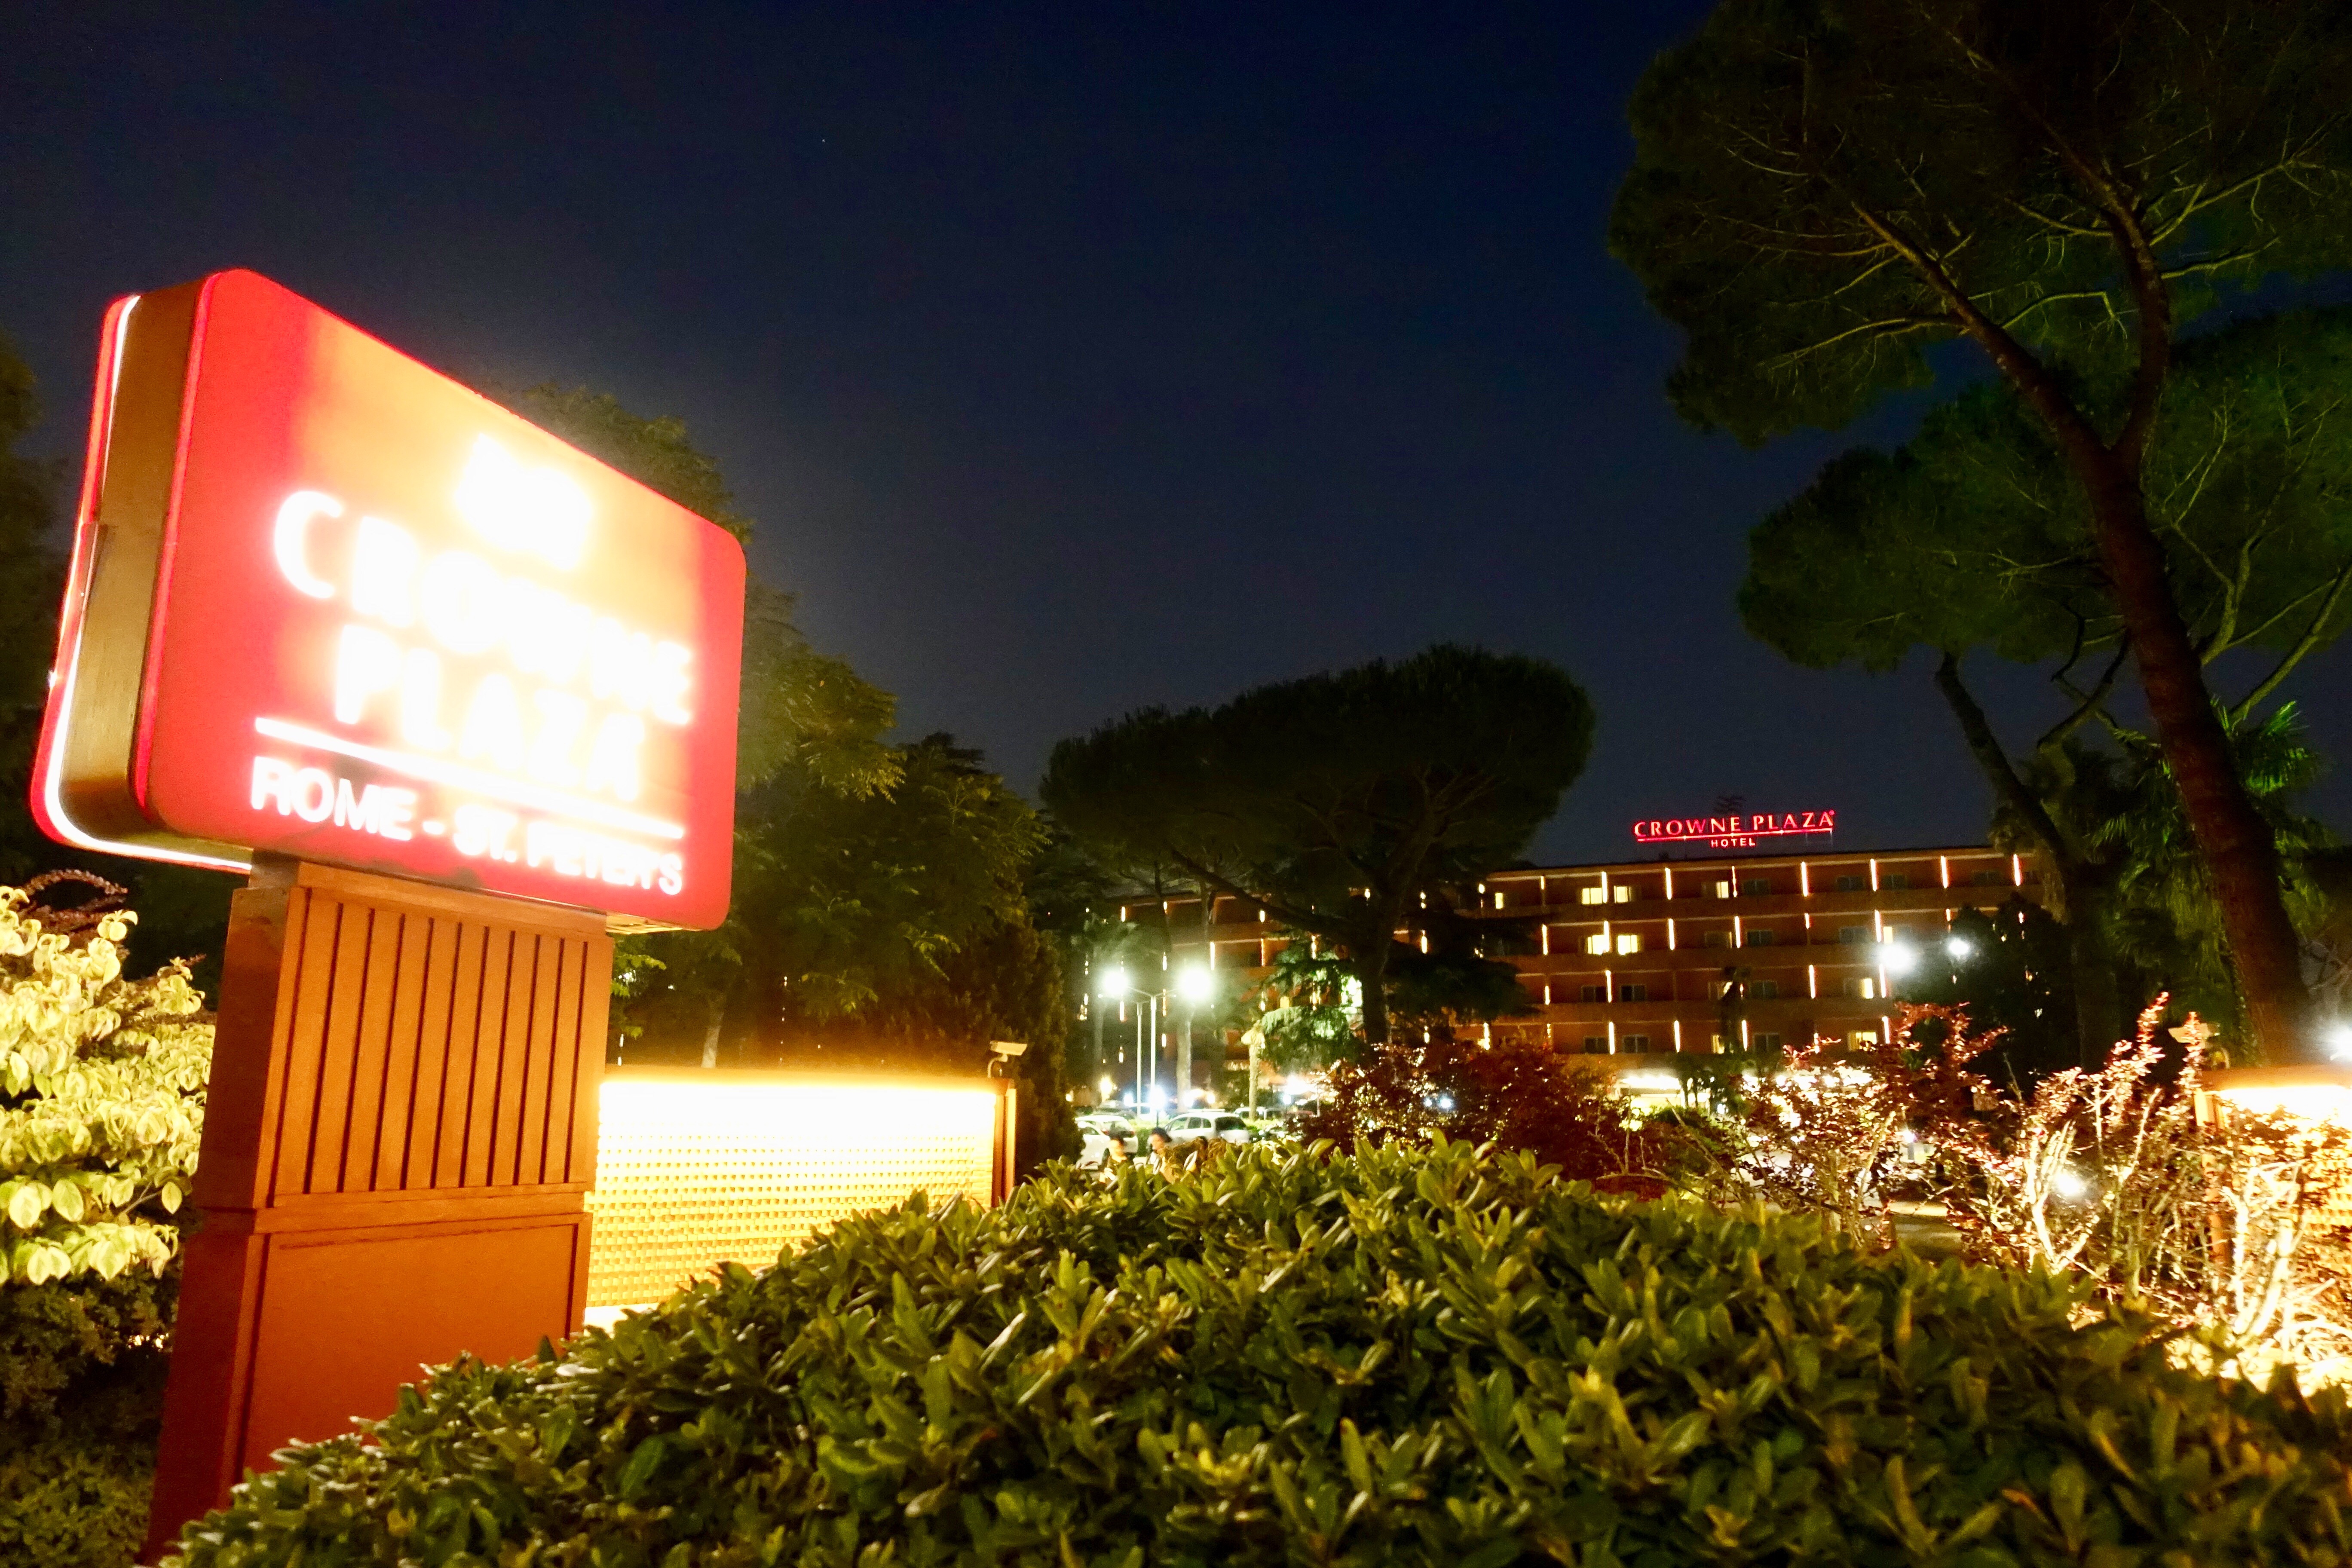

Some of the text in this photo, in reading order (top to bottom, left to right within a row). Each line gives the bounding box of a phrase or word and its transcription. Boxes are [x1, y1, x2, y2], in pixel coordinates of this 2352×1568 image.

[274, 490, 691, 725] CROWNE
[334, 624, 645, 802] PLAZA
[252, 756, 415, 841] ROME
[453, 805, 517, 862] ST.
[527, 821, 682, 895] PETER'S
[1634, 810, 1835, 836] CROWNE PLAZA
[1711, 837, 1756, 848] HOTEL
